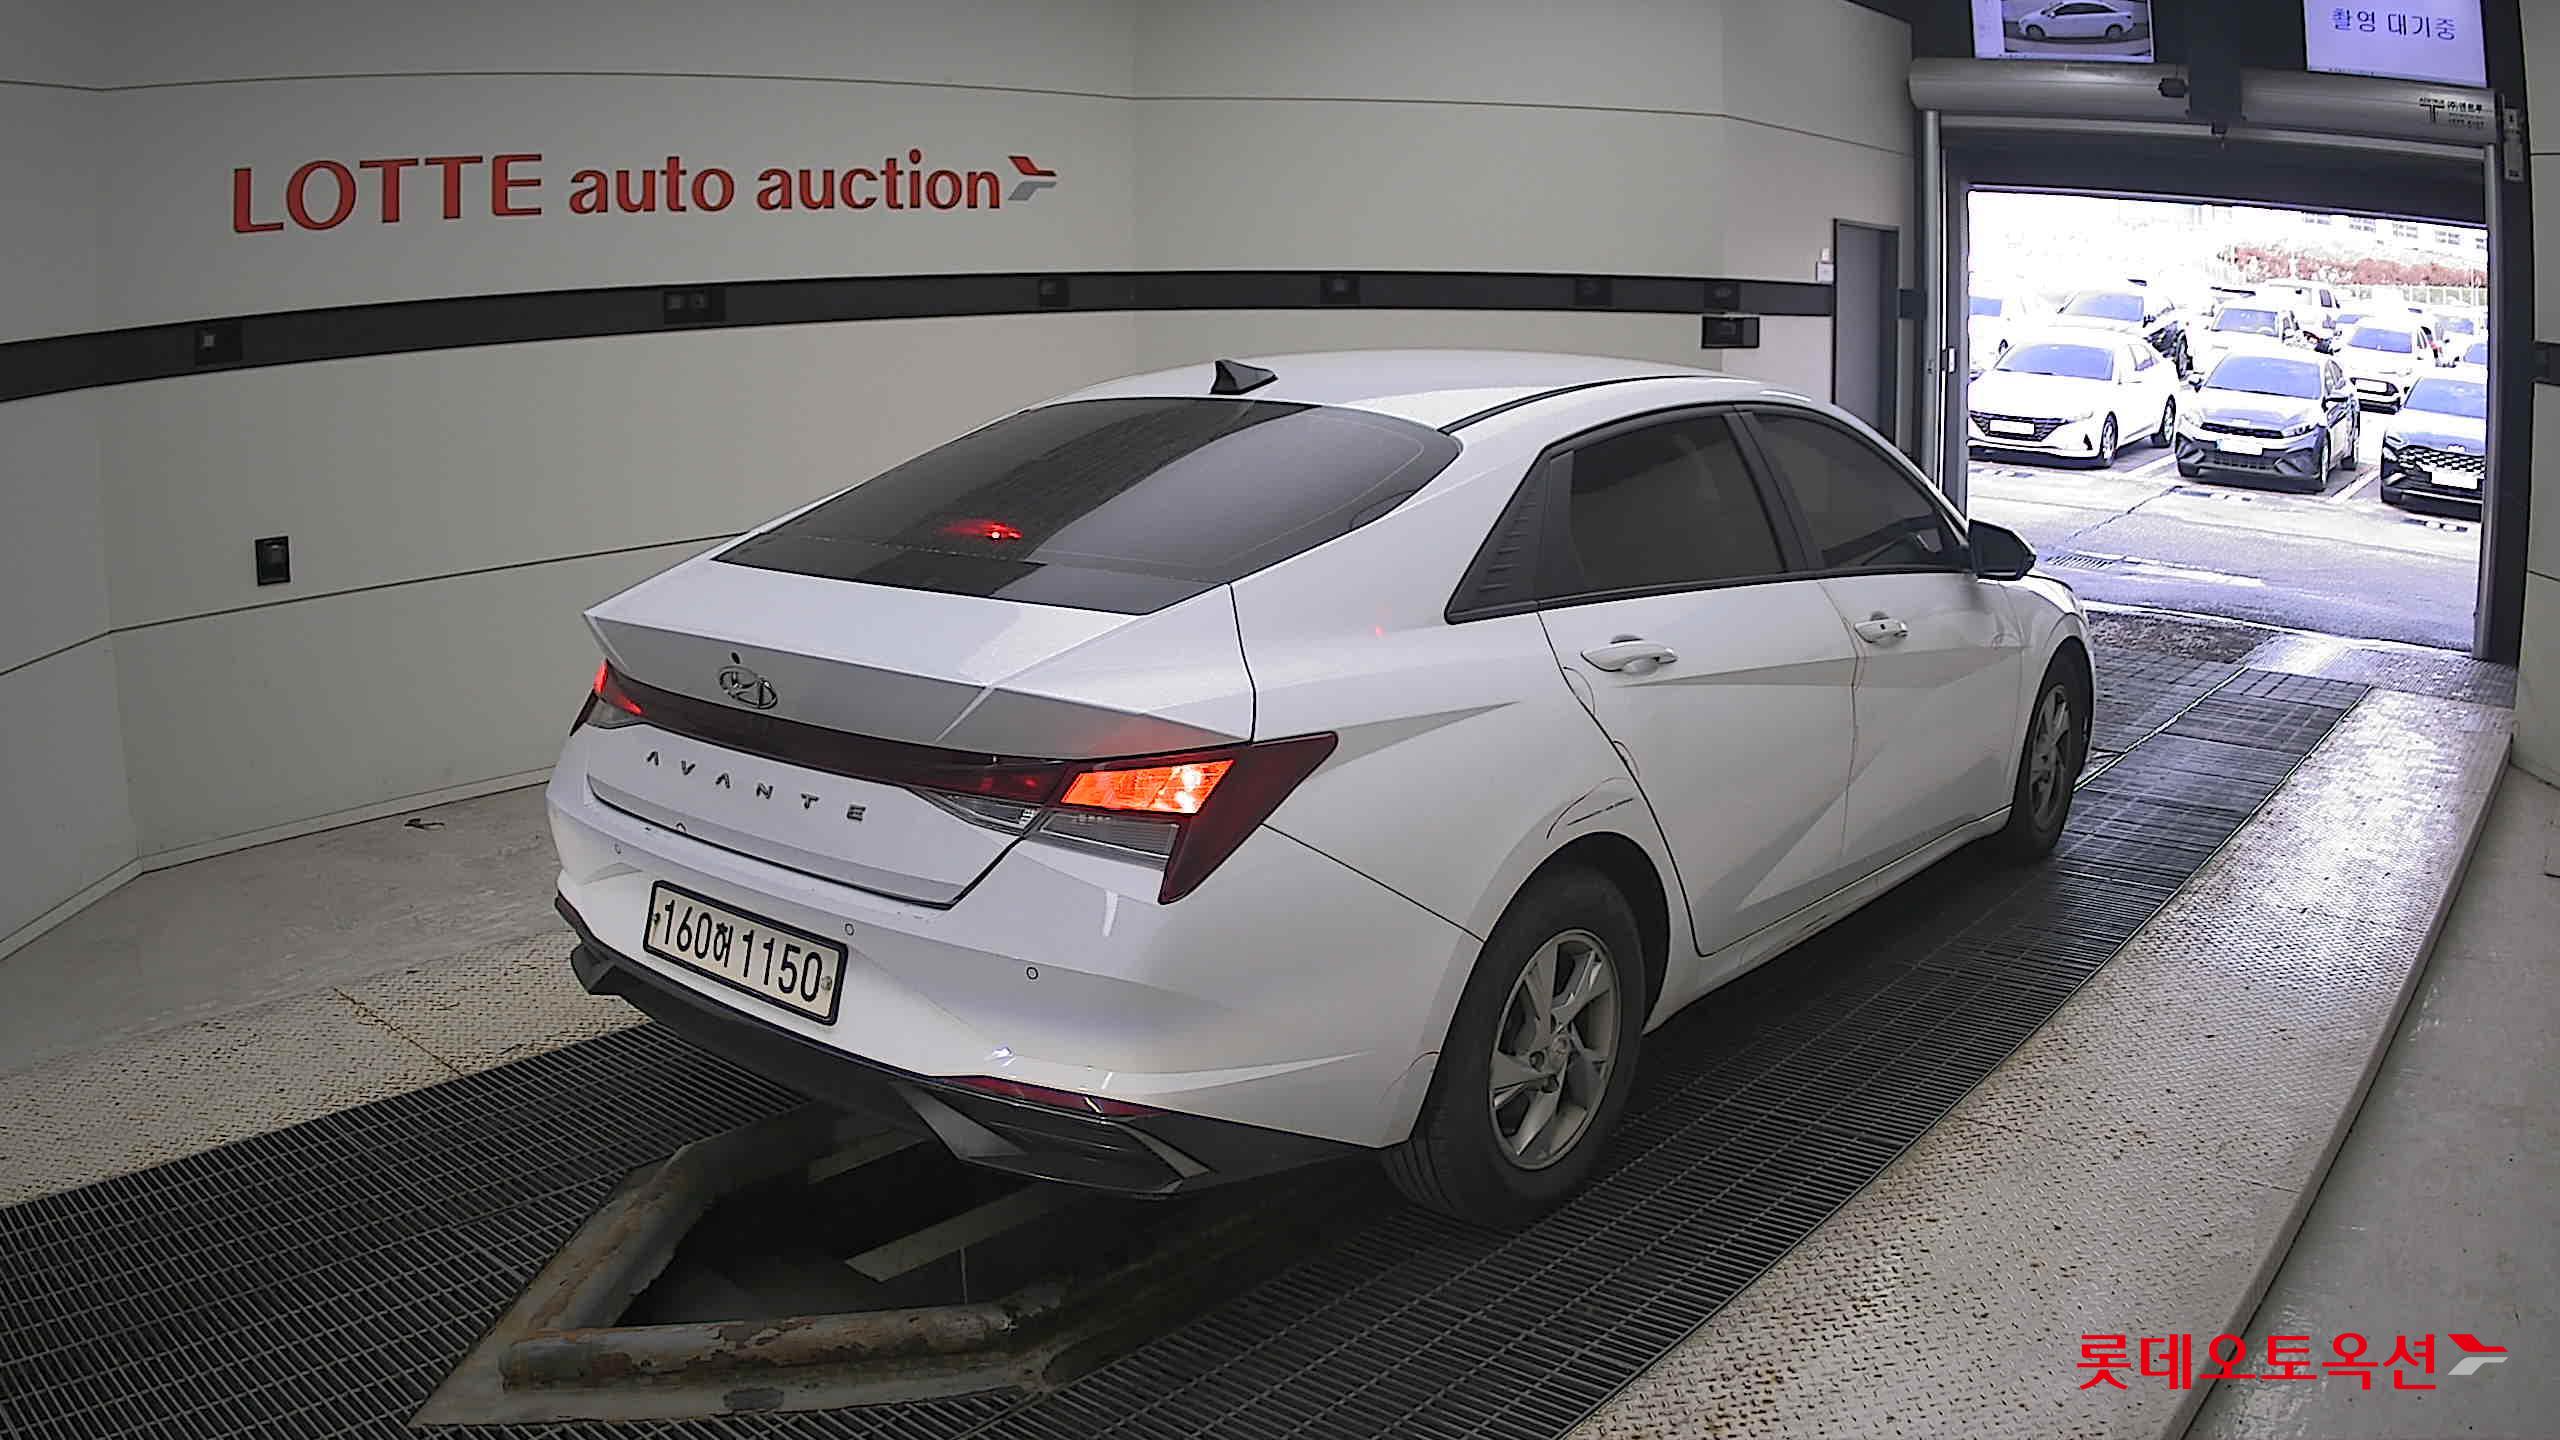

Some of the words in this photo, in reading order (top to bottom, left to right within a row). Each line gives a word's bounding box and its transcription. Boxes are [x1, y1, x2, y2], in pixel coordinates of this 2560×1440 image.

[2333, 8, 2376, 33] 촬영
[2388, 13, 2456, 40] 대기중
[233, 153, 542, 234] LOTTE
[570, 156, 735, 215] auto
[756, 148, 1002, 210] auction
[646, 750, 867, 822] AVANTE
[665, 900, 823, 1002] 160허1150
